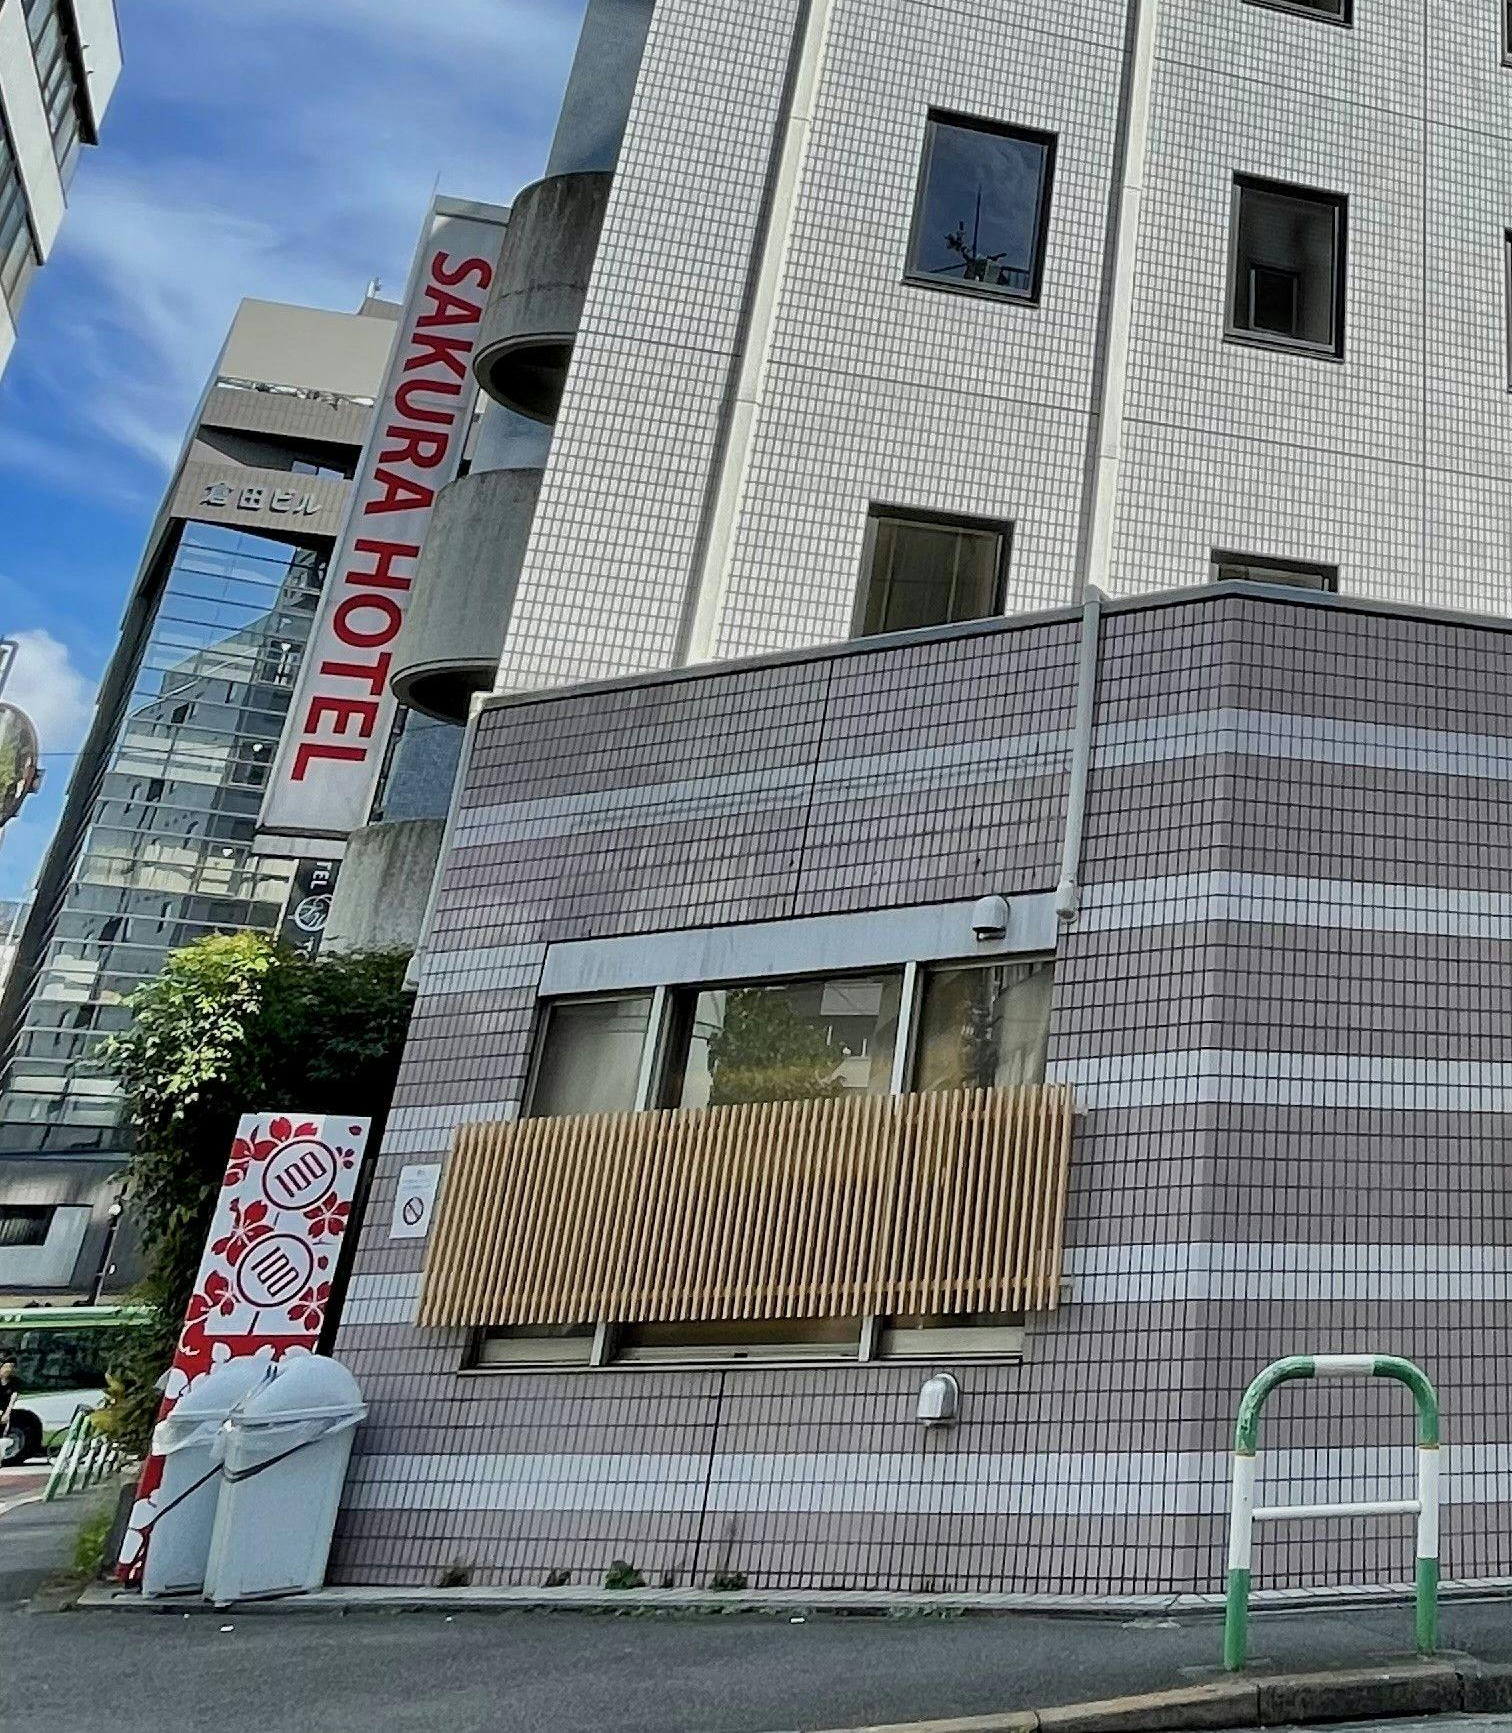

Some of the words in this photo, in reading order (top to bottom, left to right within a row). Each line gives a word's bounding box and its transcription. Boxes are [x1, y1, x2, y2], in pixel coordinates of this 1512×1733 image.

[200, 482, 322, 516] 倉田ビル
[364, 250, 493, 516] SAKURA
[290, 538, 421, 781] HOTEL
